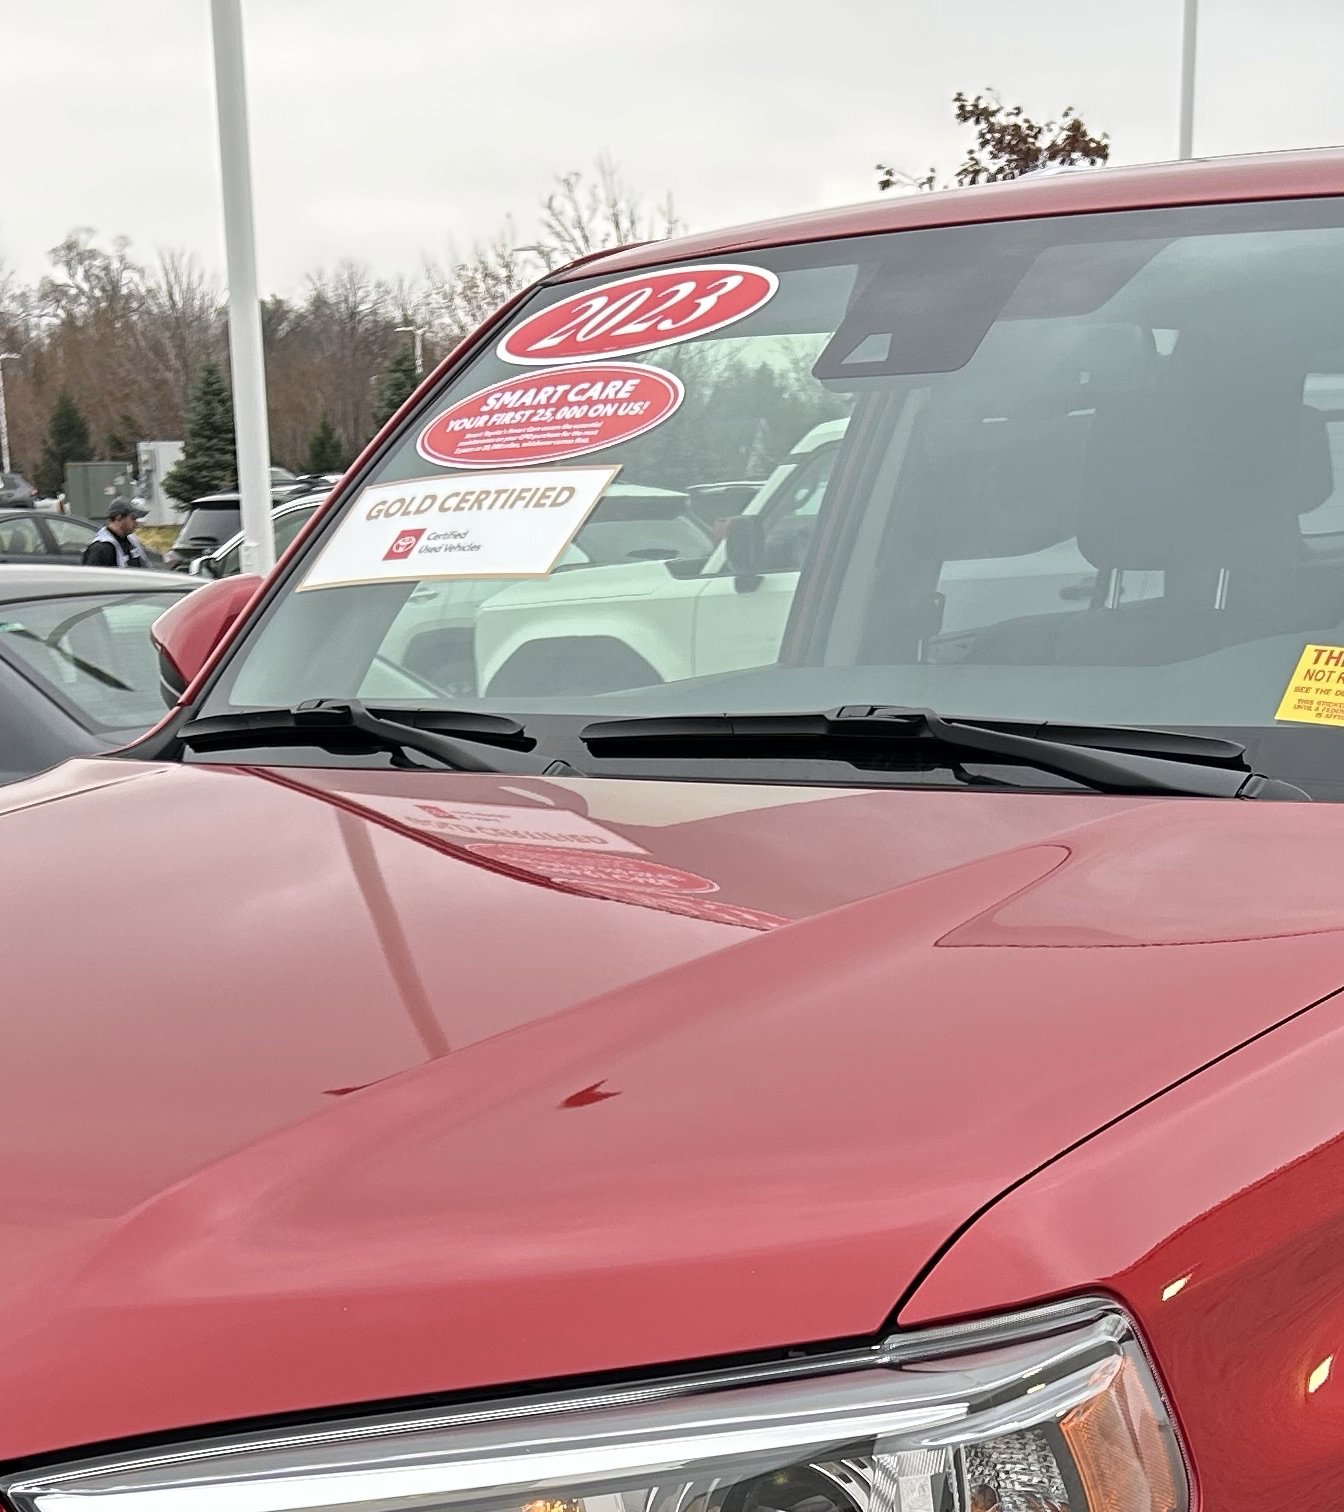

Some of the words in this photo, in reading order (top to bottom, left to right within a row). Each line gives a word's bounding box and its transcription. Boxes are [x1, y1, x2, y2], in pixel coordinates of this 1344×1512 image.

[526, 275, 744, 352] 2023
[480, 384, 570, 412] SMART
[567, 378, 641, 402] CARE
[445, 413, 491, 433] YOUR
[486, 409, 535, 428] FIRST
[530, 405, 590, 423] 25,000
[589, 402, 619, 418] ON
[616, 400, 651, 417] US!
[365, 494, 438, 521] GOLD
[438, 486, 576, 513] CERTIFIED
[418, 544, 443, 554] Used
[444, 542, 482, 553] Vehicles
[426, 530, 470, 542] Certified
[1303, 668, 1336, 683] NOT
[1293, 686, 1312, 694] SEE
[1315, 687, 1332, 695] THE
